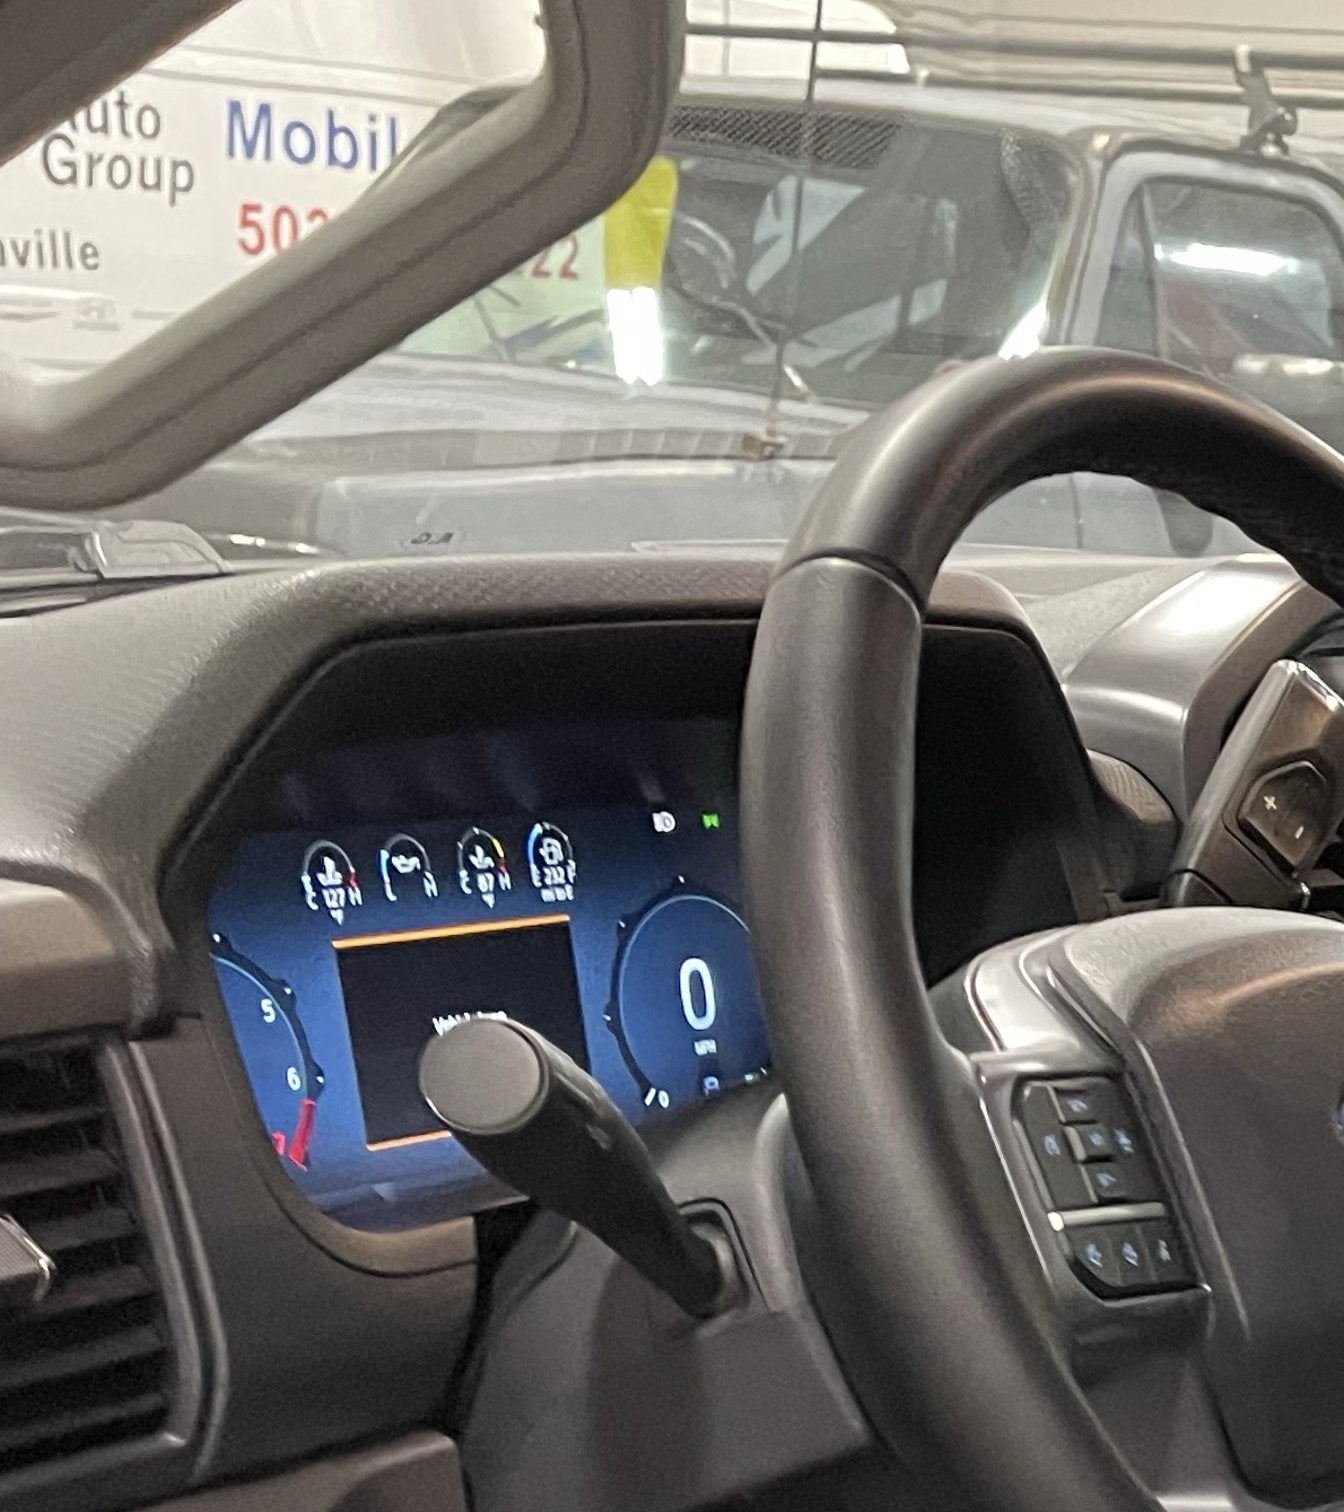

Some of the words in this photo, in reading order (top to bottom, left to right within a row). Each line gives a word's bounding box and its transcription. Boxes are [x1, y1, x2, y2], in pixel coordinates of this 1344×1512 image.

[70, 90, 161, 139] uto
[42, 132, 195, 208] Group
[0, 228, 100, 271] ville
[238, 203, 329, 257] 50
[261, 998, 276, 1024] 5
[679, 957, 717, 1031] 0
[286, 1065, 301, 1091] 6
